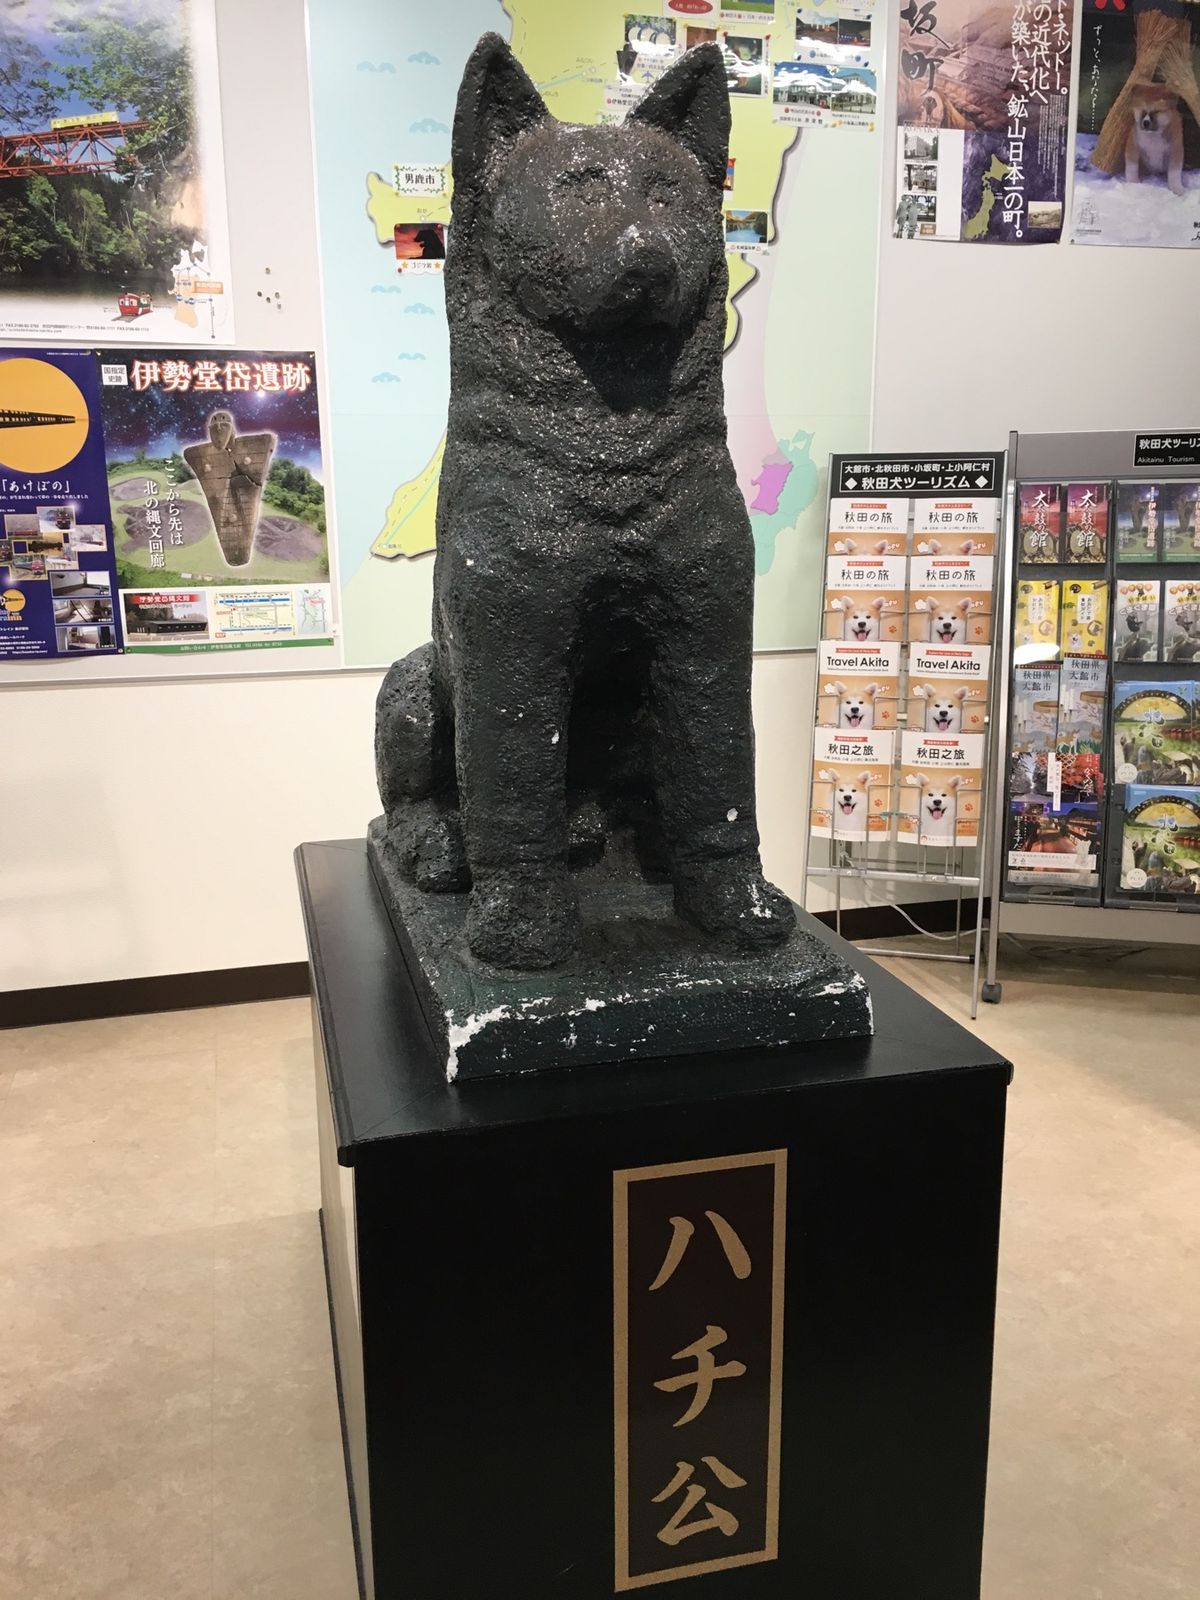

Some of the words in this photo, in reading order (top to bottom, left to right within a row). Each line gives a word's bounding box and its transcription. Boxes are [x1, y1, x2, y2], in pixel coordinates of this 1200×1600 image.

[1029, 0, 1053, 104] の近代化へ
[404, 173, 436, 185] 男鹿市
[129, 359, 312, 392] 伊勢堂岱遺跡
[1167, 455, 1195, 463] Tourism
[861, 475, 970, 490] 秋田犬ツーリズム
[165, 459, 184, 545] ここから先は
[844, 511, 893, 523] 秋田の旅
[928, 511, 978, 523] 秋田の旅
[143, 480, 166, 568] 北の縄文回廊
[841, 569, 890, 581] 秋田の旅
[926, 569, 976, 581] 秋田の旅
[826, 656, 858, 667] Travel
[860, 657, 890, 668] Akita
[916, 658, 949, 670] Travel
[950, 659, 981, 670] Akita
[827, 743, 875, 756] 秋田之旅
[916, 746, 966, 760] 秋田之旅
[648, 1210, 752, 1546] ハチ公
